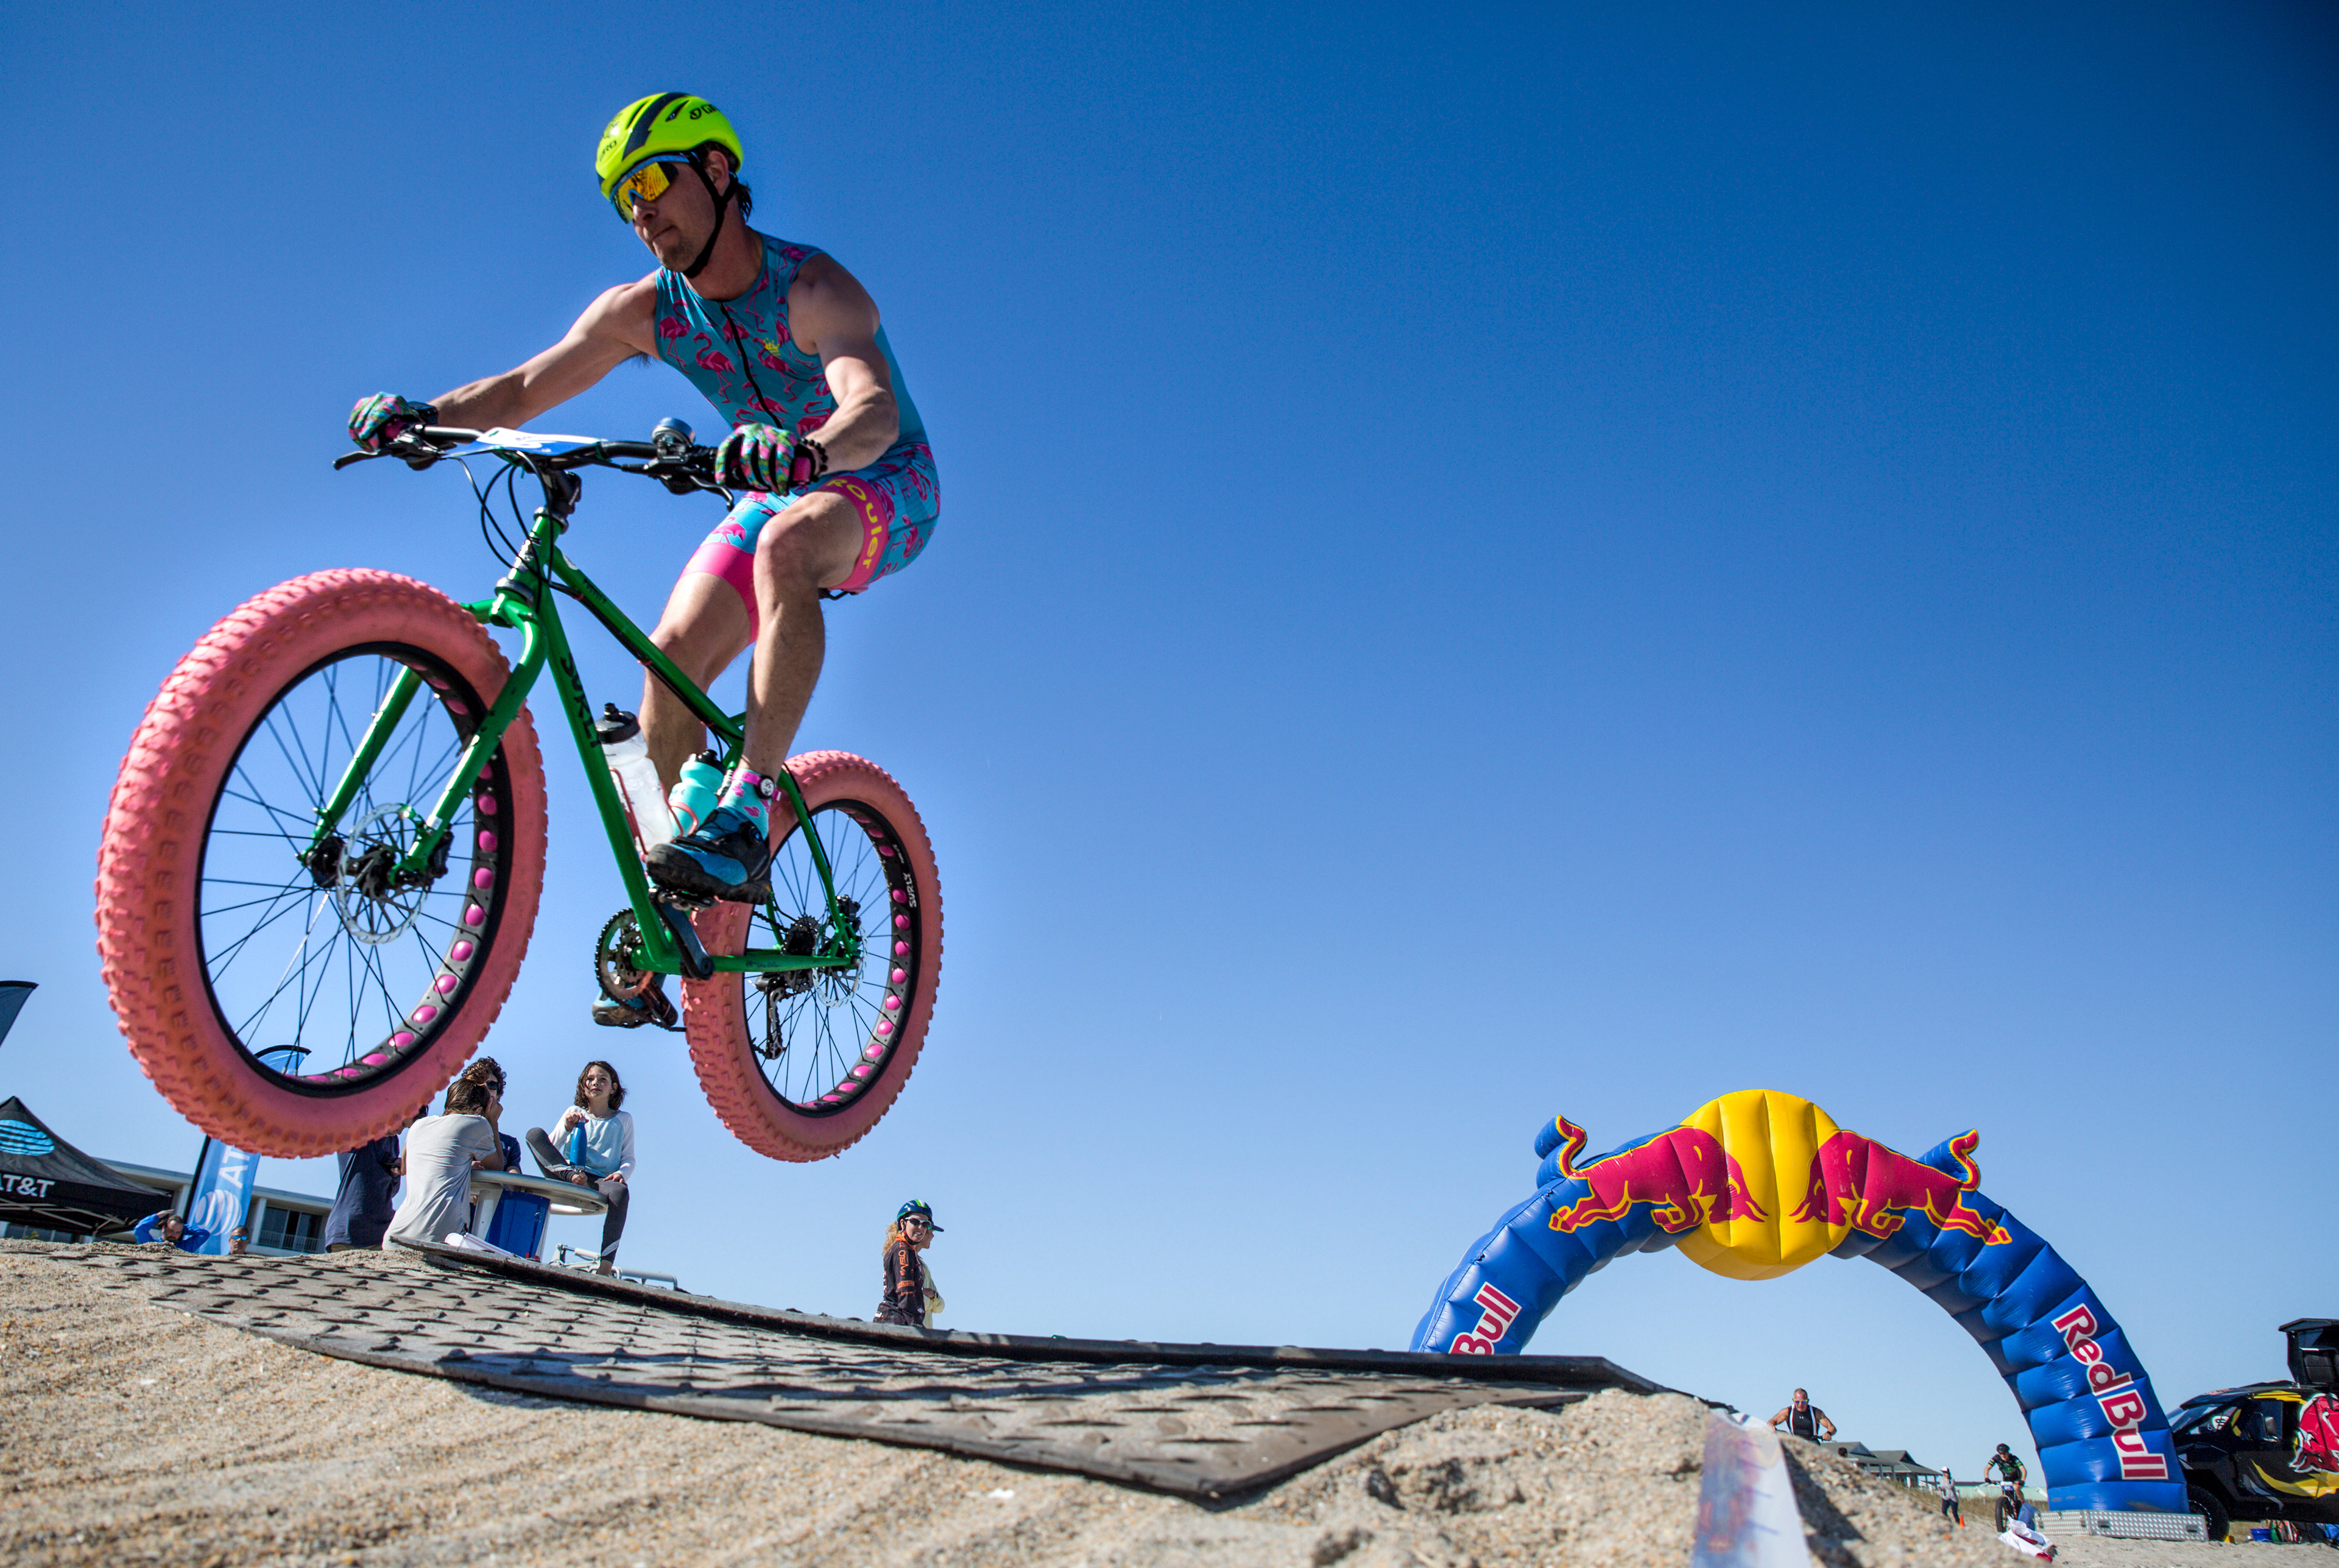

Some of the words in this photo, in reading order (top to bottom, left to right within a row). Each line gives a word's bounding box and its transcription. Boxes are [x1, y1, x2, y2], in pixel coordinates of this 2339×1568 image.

[0, 1173, 55, 1198] T&T
[898, 1249, 909, 1270] VELO
[1450, 1284, 1520, 1355] Bull
[2053, 1305, 2131, 1394] Red
[2101, 1391, 2167, 1477] Bull
